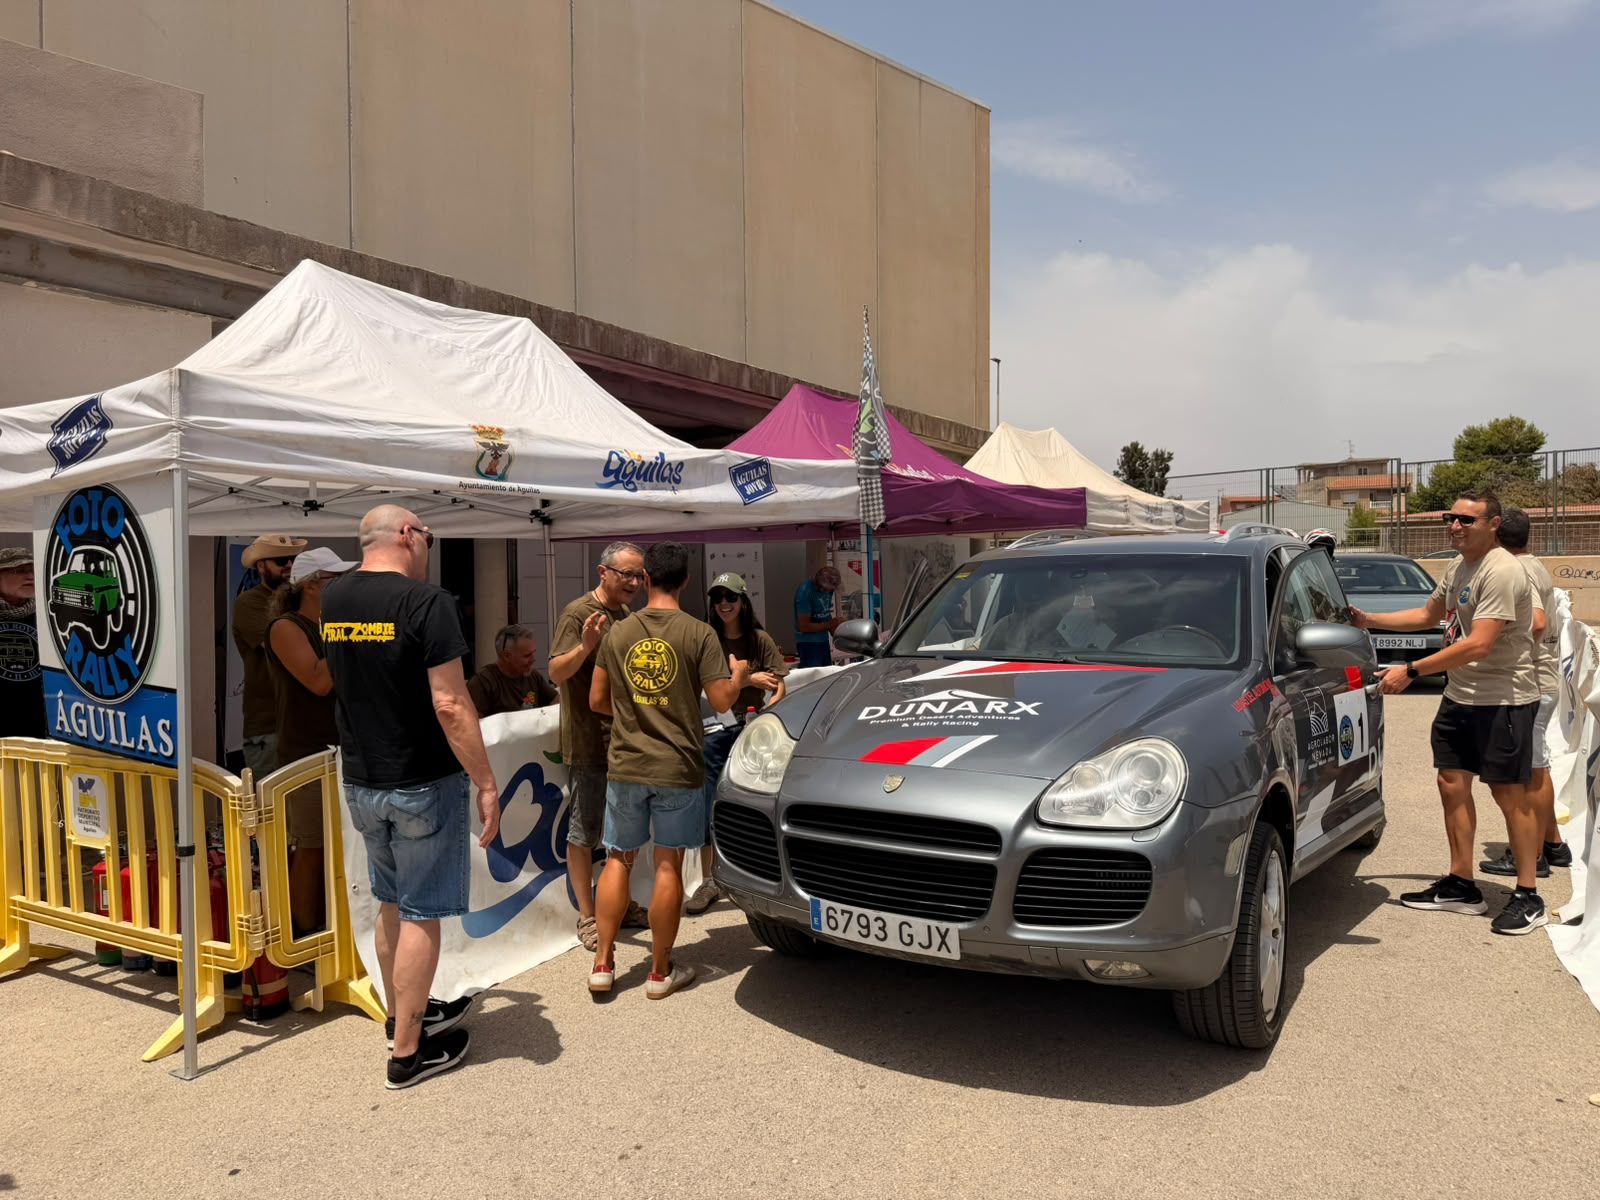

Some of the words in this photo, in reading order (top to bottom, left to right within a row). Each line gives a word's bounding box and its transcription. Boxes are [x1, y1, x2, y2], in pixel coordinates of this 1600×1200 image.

[458, 481, 507, 492] Ayuntamiento
[55, 490, 126, 555] FOTO
[348, 622, 396, 643] ZOMBIE
[634, 641, 665, 655] FOTO
[1379, 639, 1403, 648] 8992
[1405, 639, 1425, 648] NLJ
[65, 633, 142, 697] RALLY
[633, 673, 668, 690] RALLY
[857, 700, 1043, 721] DUNARX
[869, 717, 916, 725] Premium
[55, 689, 174, 757] ÁGUILAS
[1358, 711, 1364, 753] 1
[814, 917, 819, 925] E
[825, 906, 888, 942] 6793
[898, 921, 952, 954] GJX
